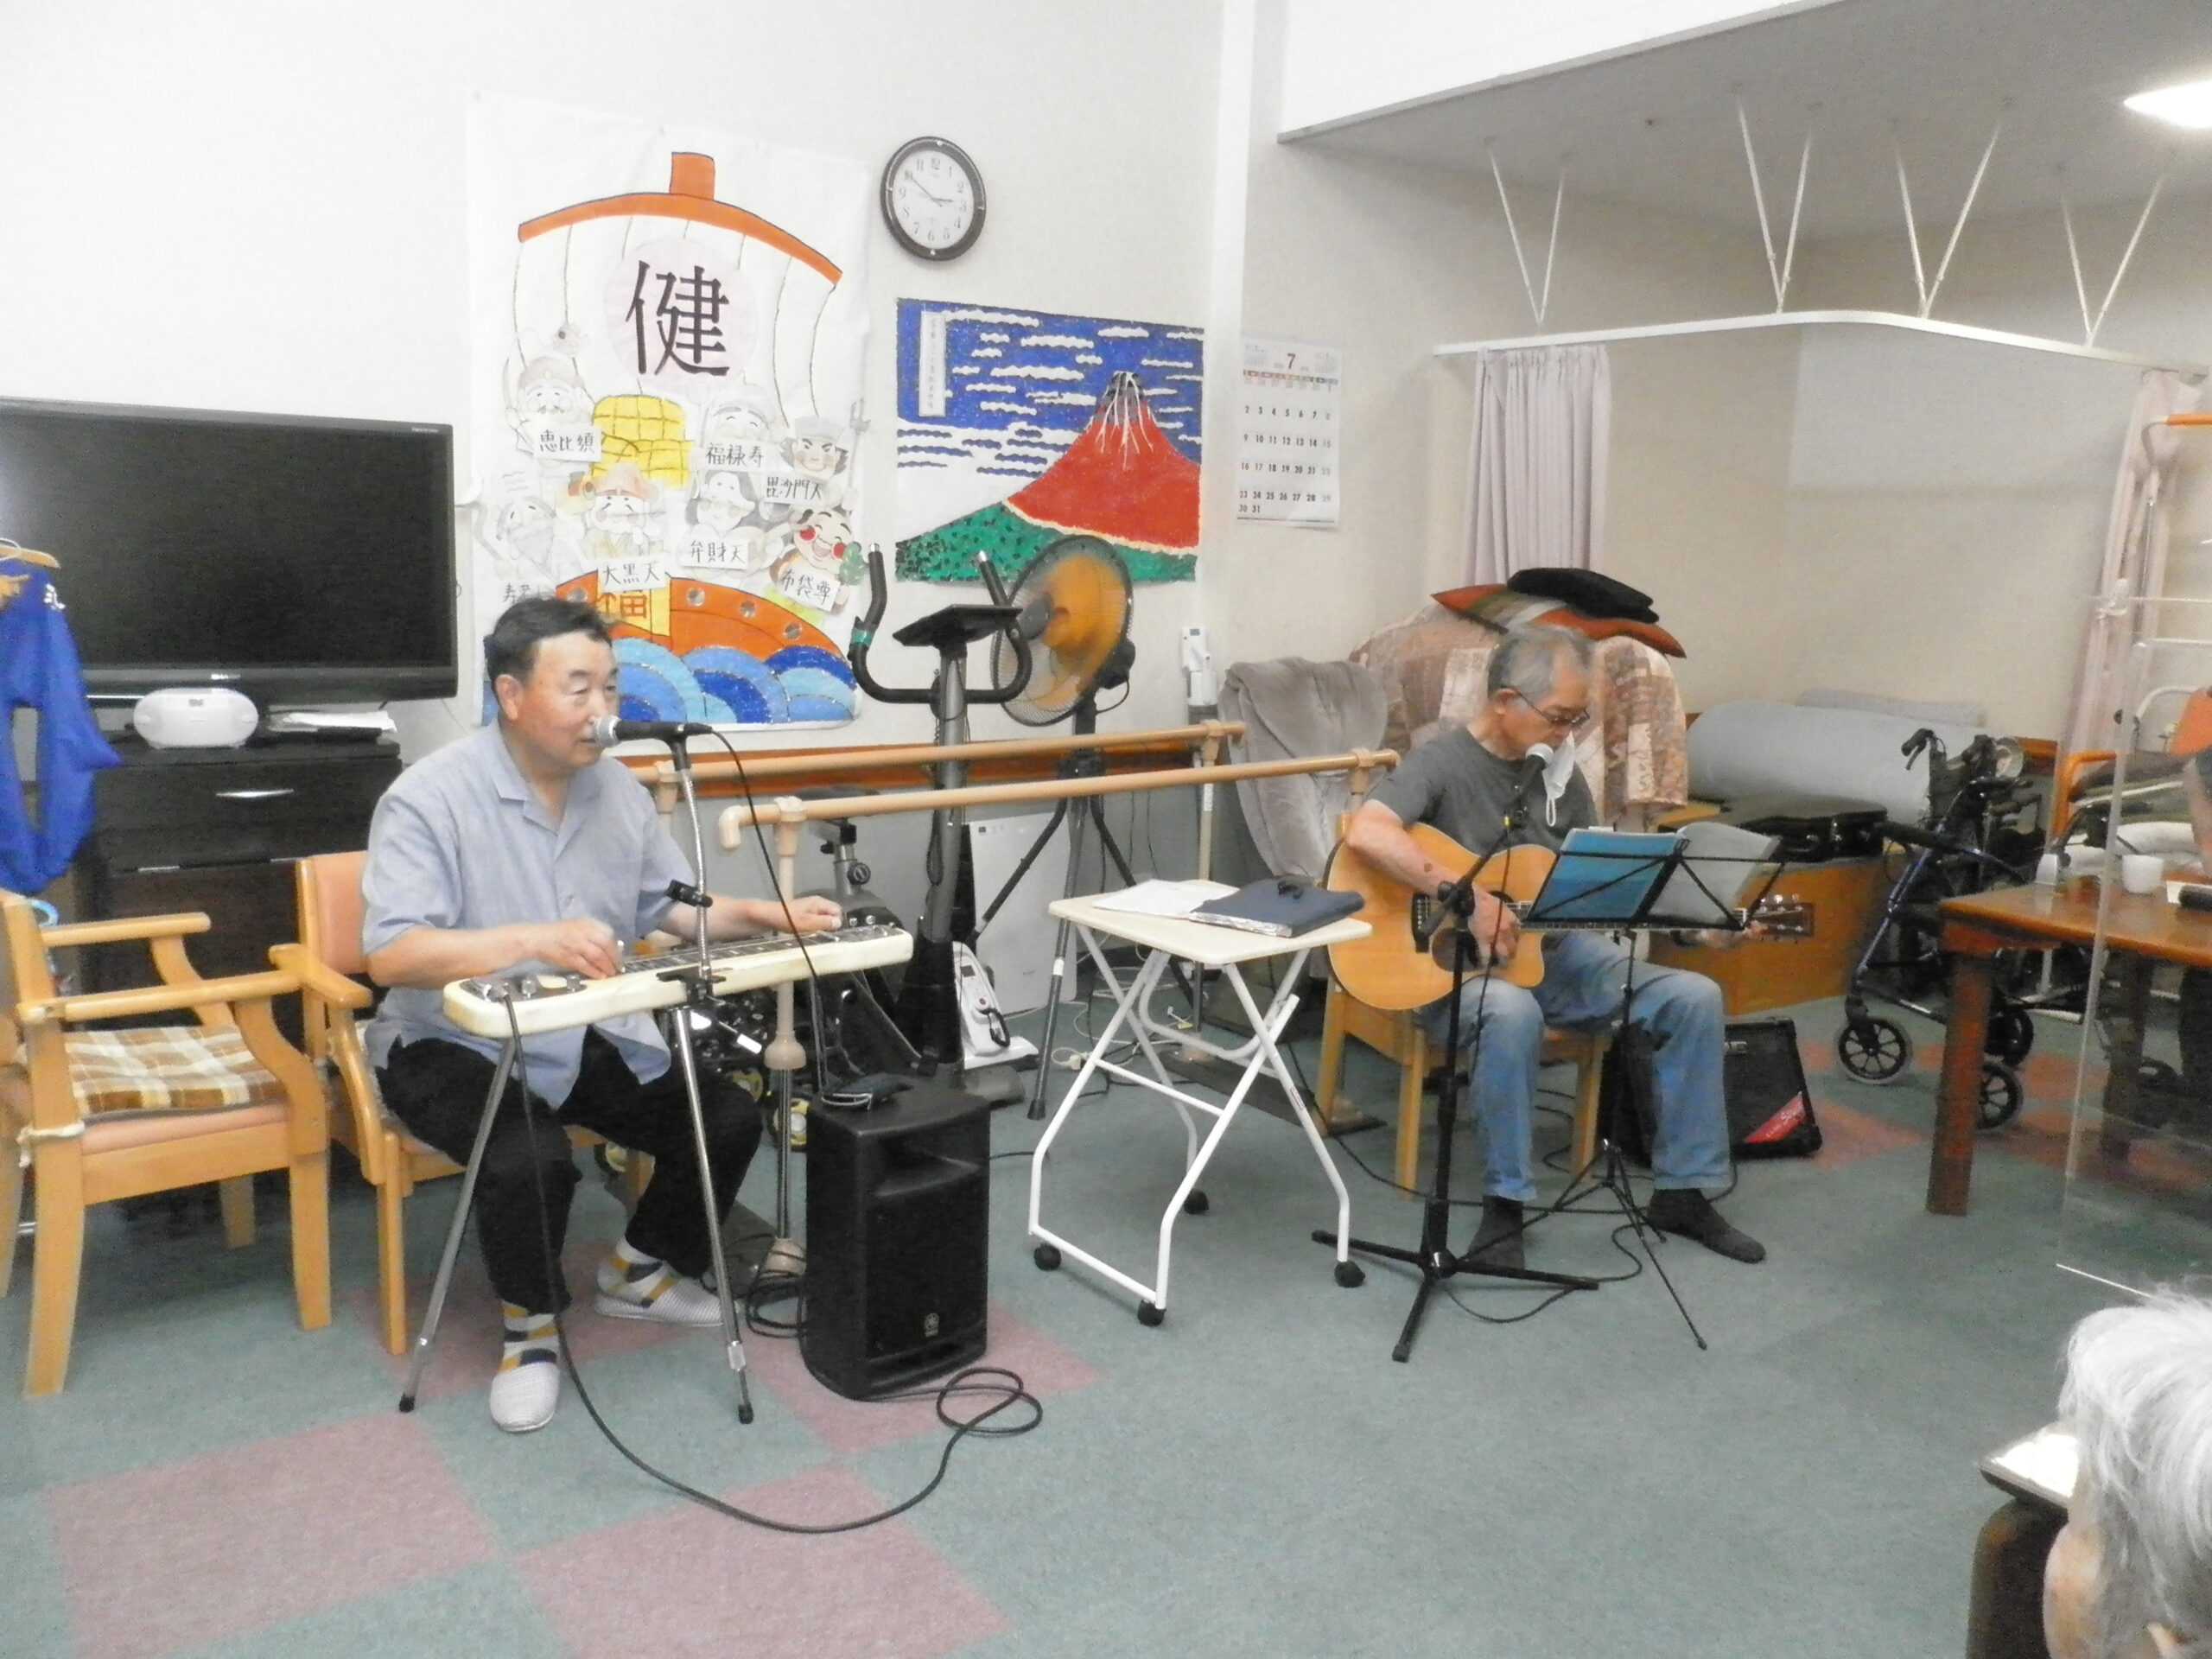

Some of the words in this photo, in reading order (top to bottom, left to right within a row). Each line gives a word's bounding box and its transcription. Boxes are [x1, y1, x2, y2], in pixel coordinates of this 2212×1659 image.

[917, 159, 924, 171] 11
[957, 181, 964, 194] 2
[626, 259, 730, 377] 健
[1287, 353, 1296, 370] 7
[1245, 405, 1249, 414] 2
[1258, 406, 1262, 415] 3
[1285, 409, 1289, 417] 5
[1299, 410, 1303, 418] 6
[540, 429, 594, 454] 恵比須
[1255, 435, 1264, 443] 10
[1269, 435, 1276, 444] 11
[1282, 436, 1291, 445] 12
[1296, 437, 1304, 446] 13
[705, 442, 764, 467] 福禄寿
[1242, 462, 1249, 471] 16
[1294, 465, 1303, 474] 20
[766, 477, 822, 500] 毘沙門天
[1266, 492, 1274, 500] 25
[1252, 505, 1261, 513] 31
[690, 540, 746, 564] 弁財天
[602, 561, 659, 586] 大黒天
[503, 582, 543, 604] 寿老
